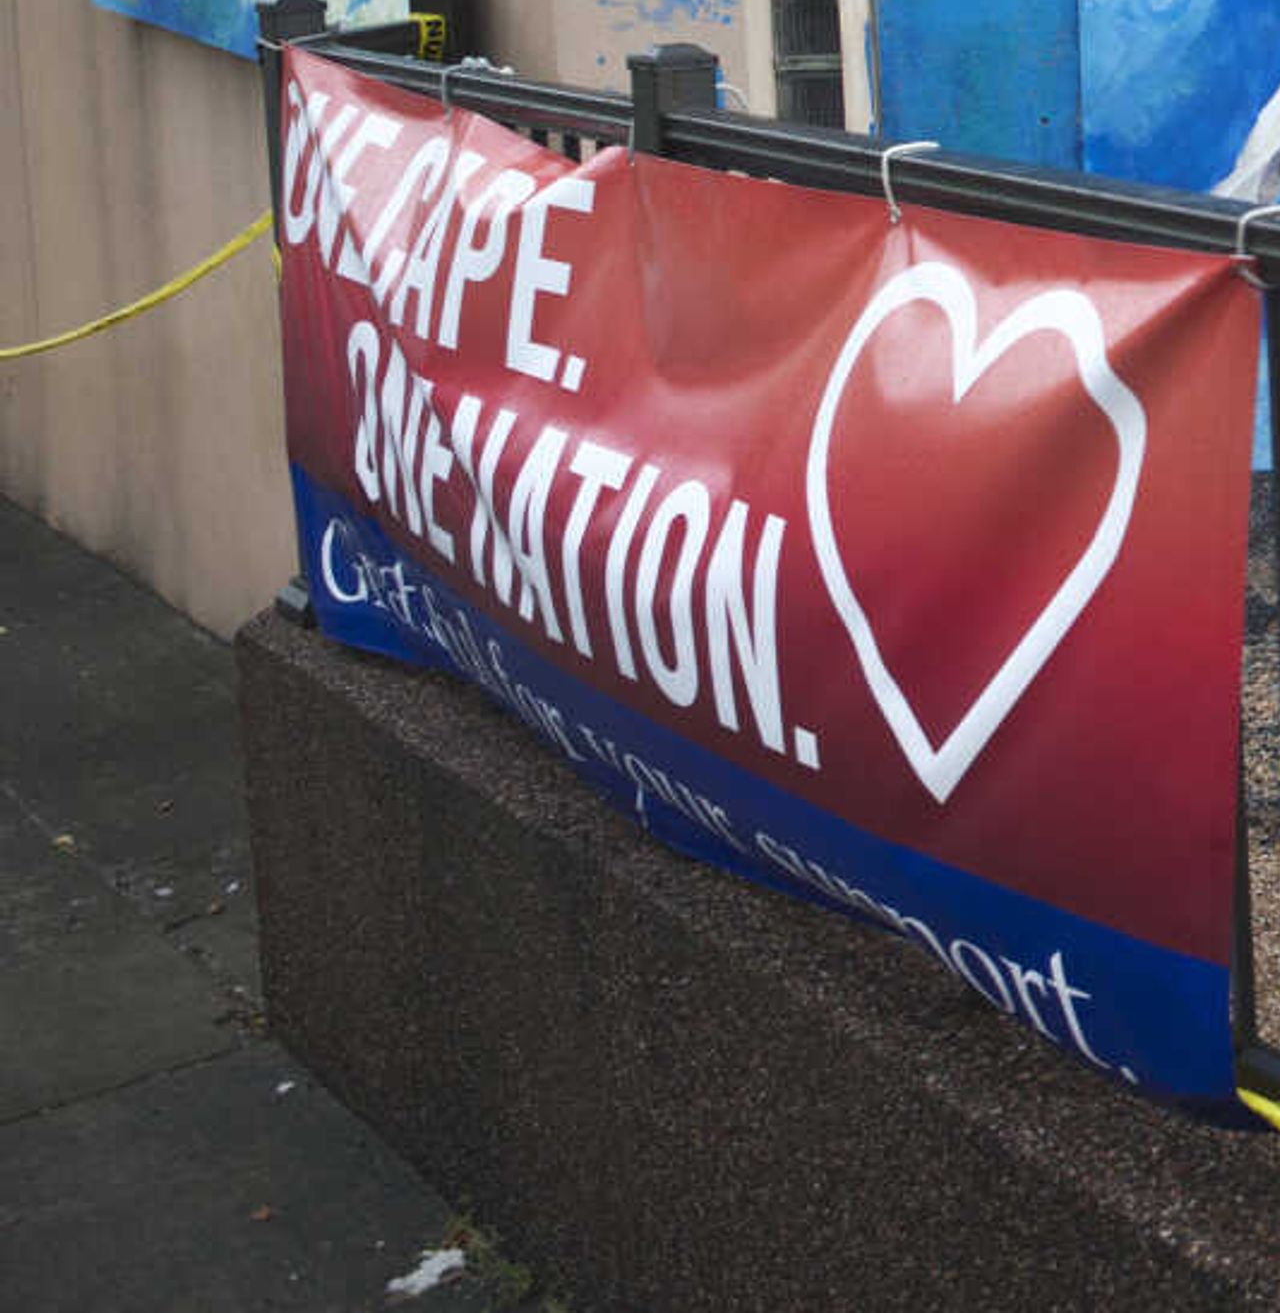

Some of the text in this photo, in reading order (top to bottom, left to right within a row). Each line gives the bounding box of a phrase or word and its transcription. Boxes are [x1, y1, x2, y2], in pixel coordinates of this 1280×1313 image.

[283, 78, 597, 392] ONE CAPE.
[451, 392, 820, 770] NATION.
